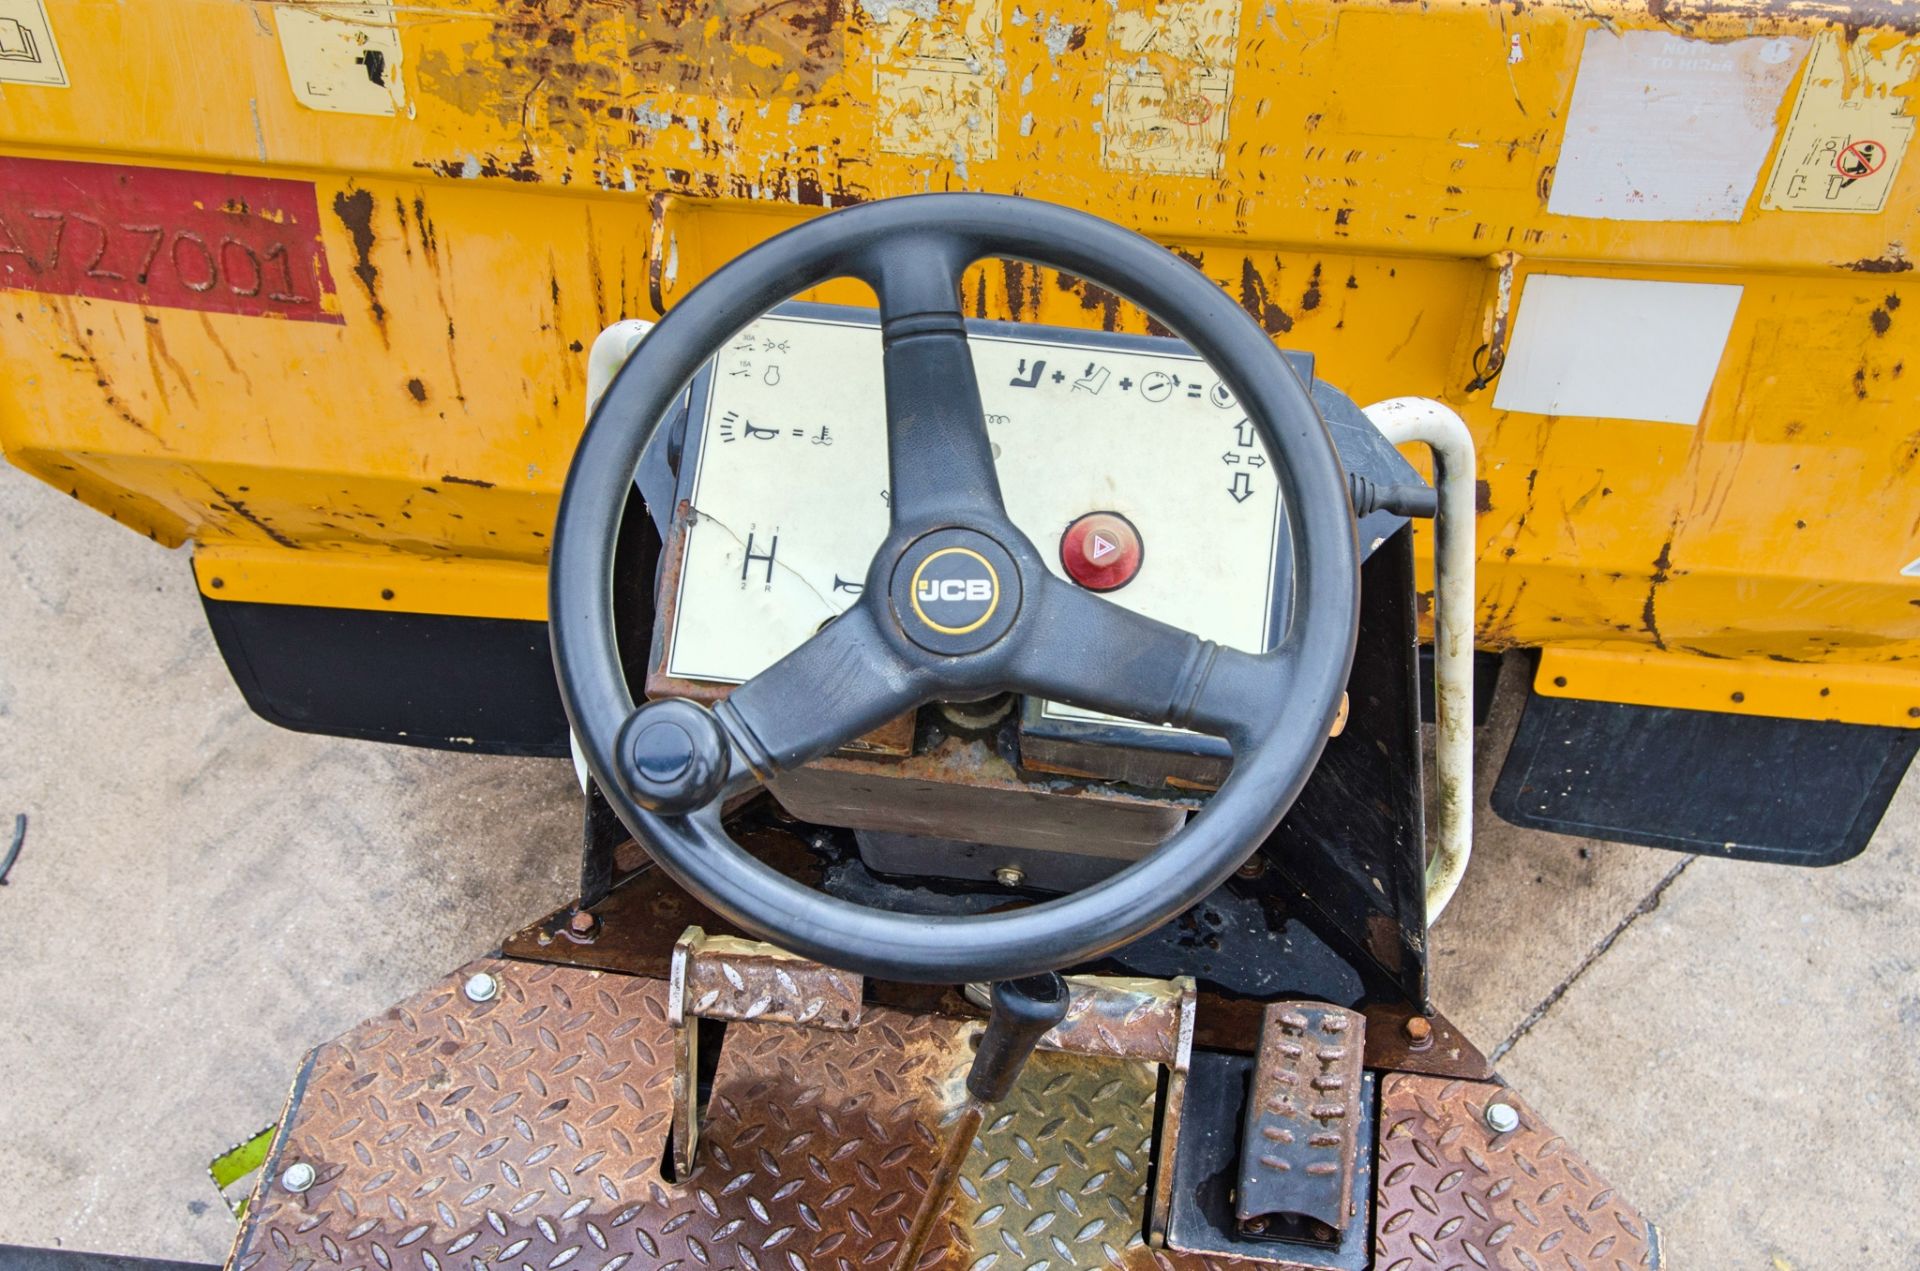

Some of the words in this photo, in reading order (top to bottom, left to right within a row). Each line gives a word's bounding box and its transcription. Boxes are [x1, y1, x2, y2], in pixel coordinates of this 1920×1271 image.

[1651, 57, 1673, 70] TO
[741, 582, 747, 590] 2
[765, 584, 772, 592] R
[918, 579, 992, 602] JCB
